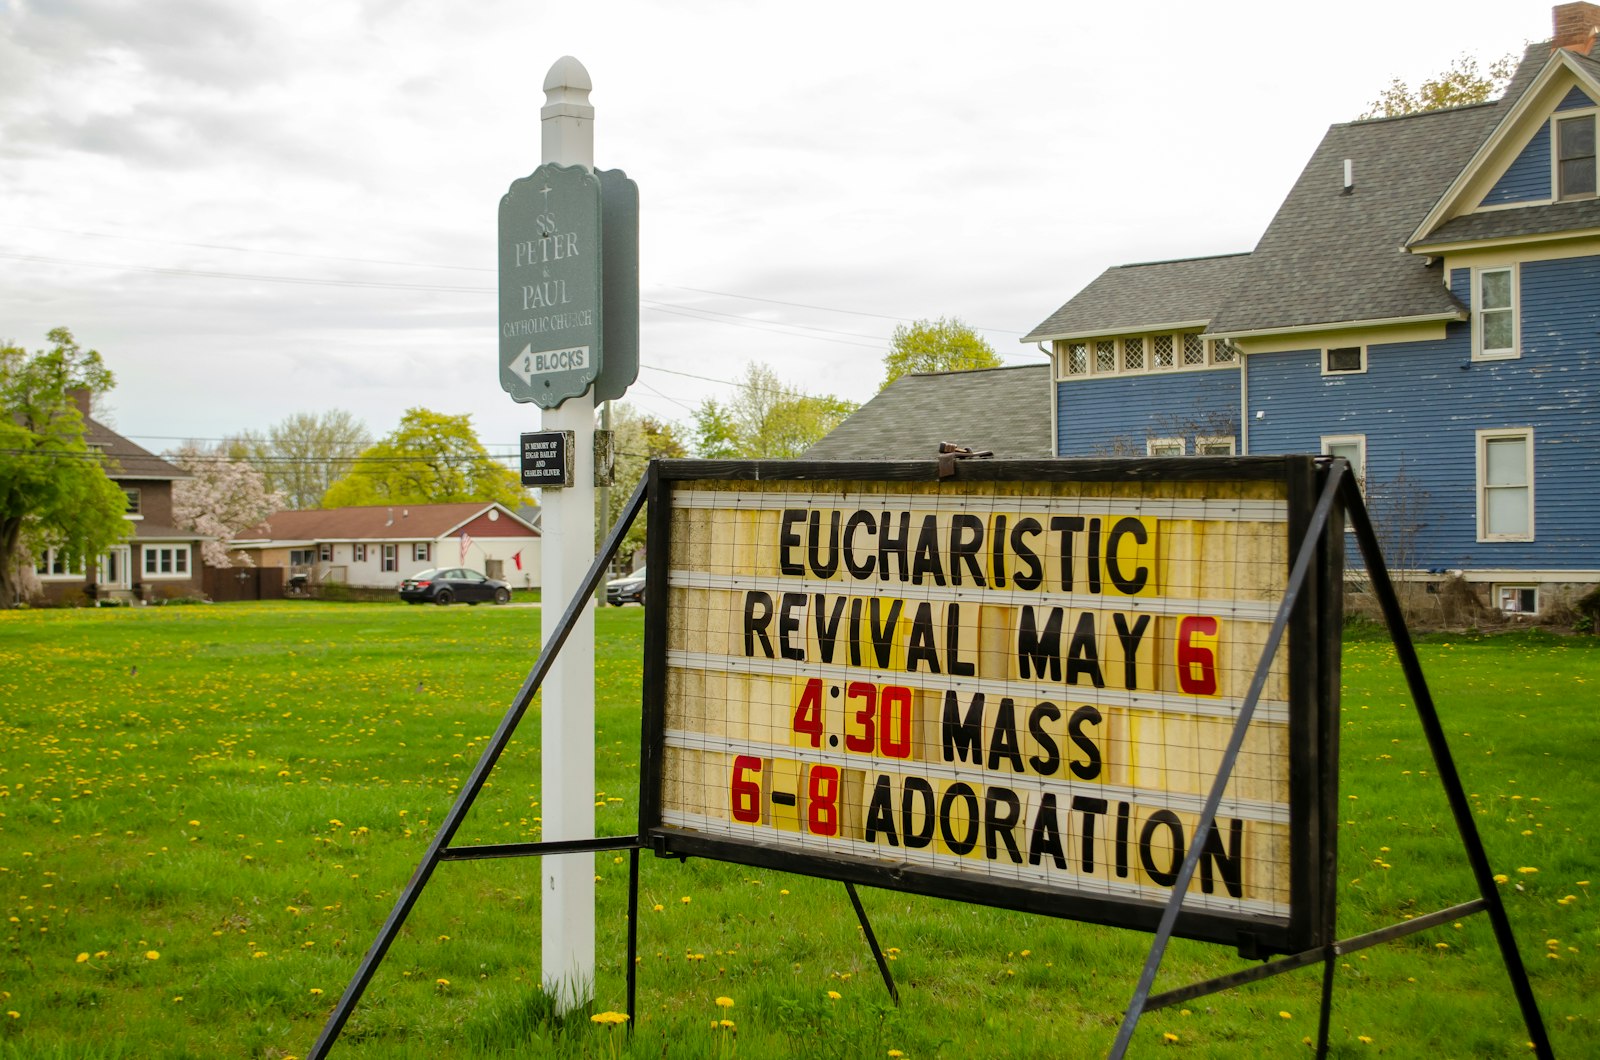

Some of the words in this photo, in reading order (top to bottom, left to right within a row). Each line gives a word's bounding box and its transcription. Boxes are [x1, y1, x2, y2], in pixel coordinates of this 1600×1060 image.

[515, 232, 580, 267] PETER
[521, 279, 572, 310] PAUL
[503, 316, 549, 338] CATHOLIC
[524, 356, 531, 372] 2
[535, 349, 584, 371] BLOCKS
[535, 460, 546, 468] AND
[779, 508, 1150, 595] EUCHARISTIC
[744, 590, 976, 678] REVIVAL
[1016, 604, 1152, 691] MAY
[1177, 615, 1218, 695] 6
[792, 678, 912, 759] 4:30
[941, 689, 1103, 781] MASS
[864, 773, 1244, 899] ADORATION
